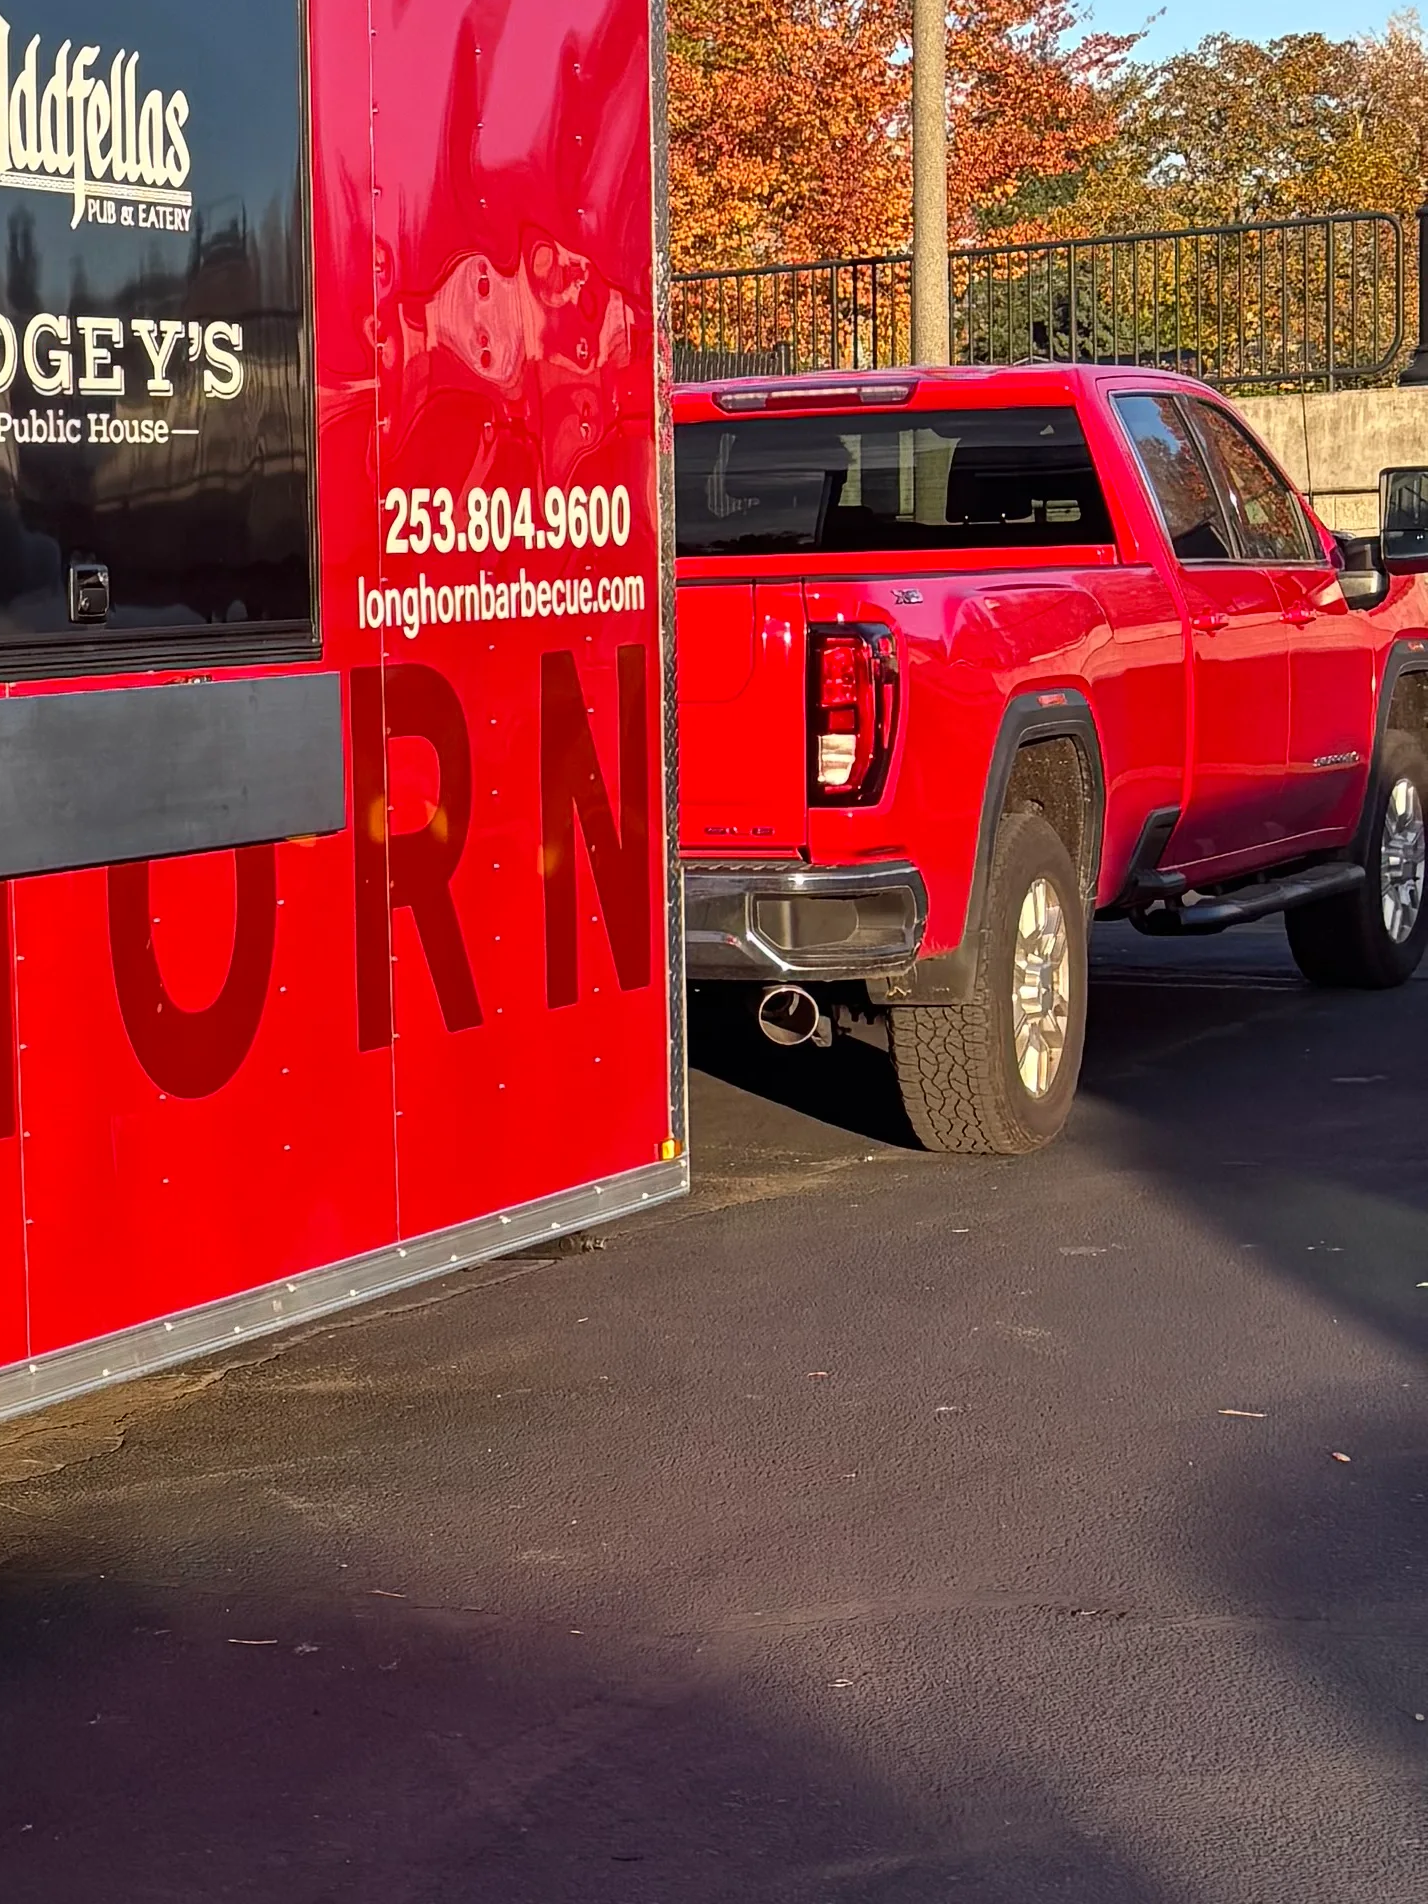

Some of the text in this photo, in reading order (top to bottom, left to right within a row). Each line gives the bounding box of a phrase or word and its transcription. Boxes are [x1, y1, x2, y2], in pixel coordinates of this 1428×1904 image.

[87, 199, 192, 232] PUB & EATERY
[87, 413, 170, 443] House
[384, 484, 631, 554] 253.804.9600
[358, 567, 645, 639] longhornbarbecue.com
